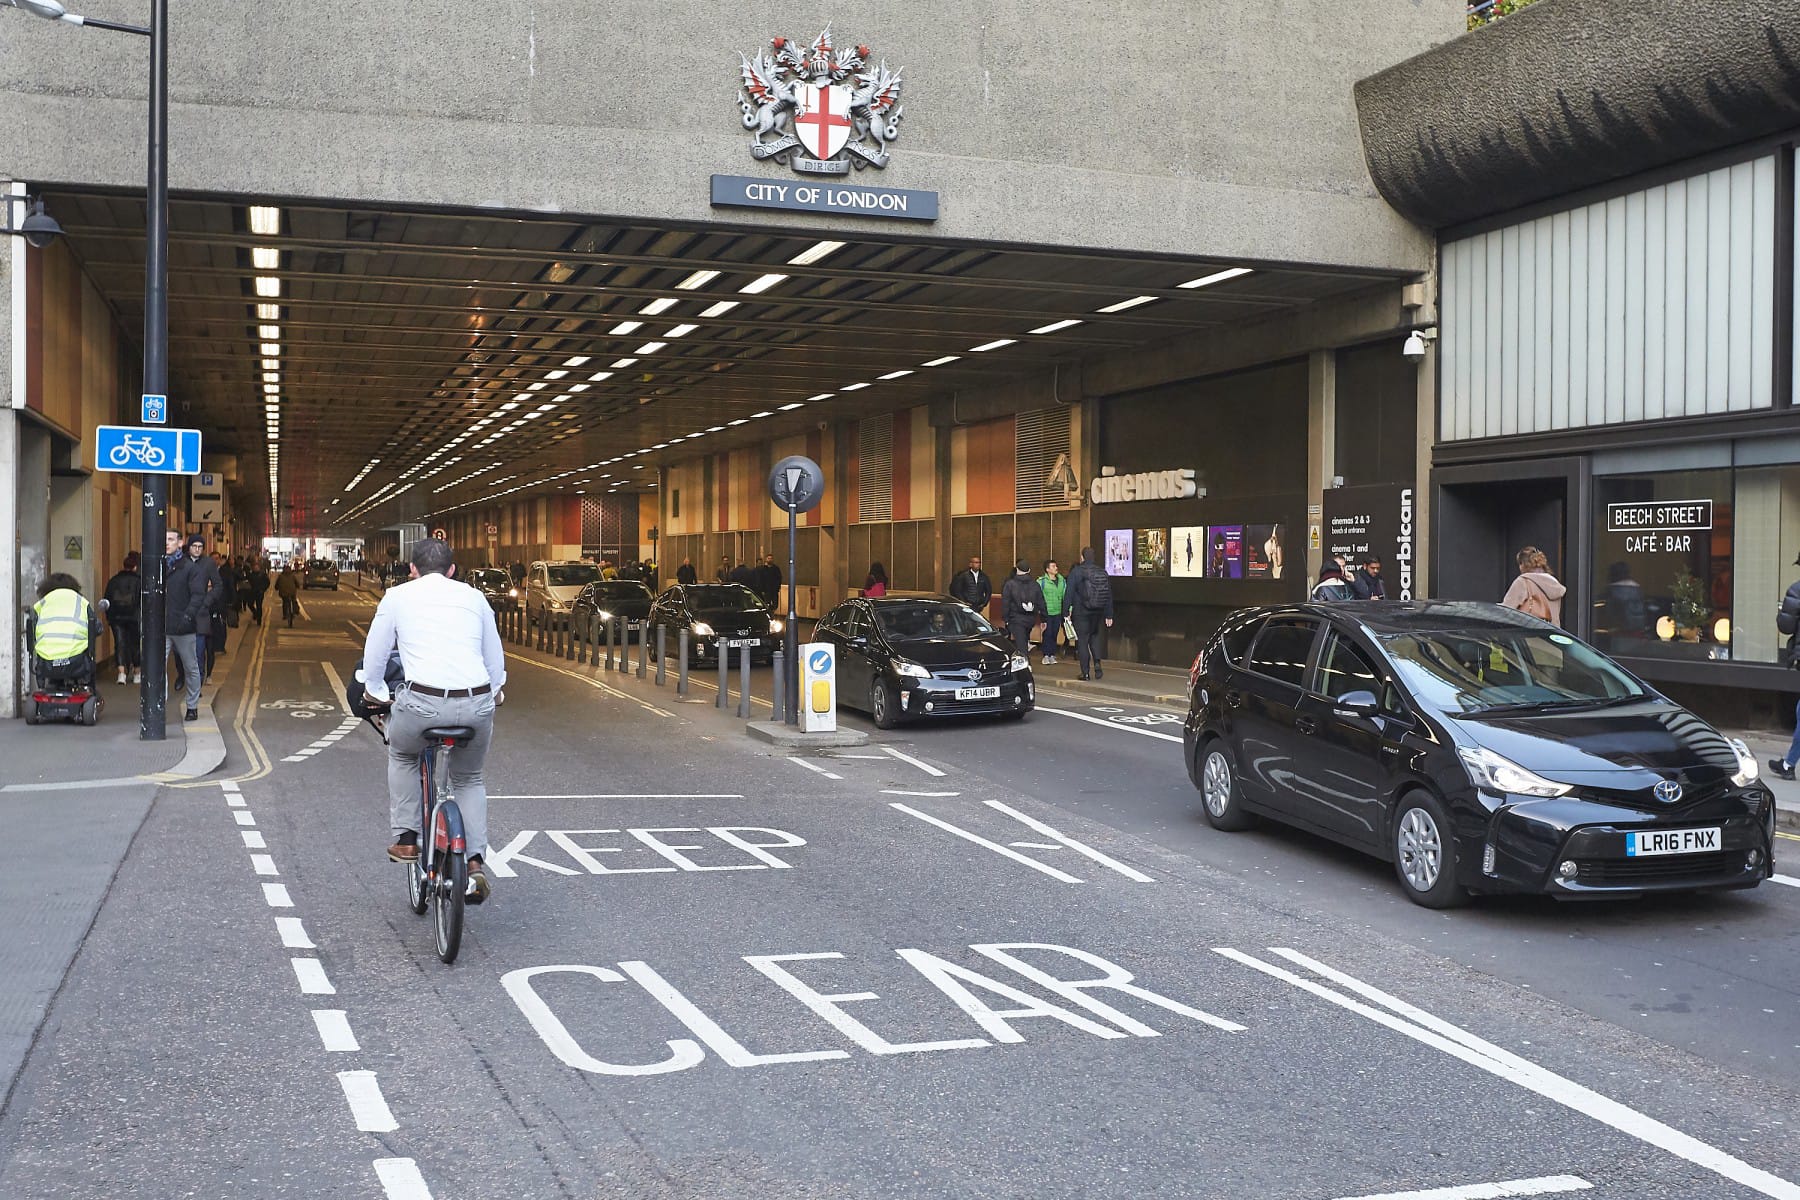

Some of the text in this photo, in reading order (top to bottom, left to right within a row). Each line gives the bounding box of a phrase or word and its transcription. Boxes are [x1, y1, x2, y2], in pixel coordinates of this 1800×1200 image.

[804, 161, 841, 172] DIRIGE
[853, 142, 878, 160] NOS
[745, 184, 907, 211] CITY OF LONDON
[1091, 466, 1196, 504] cinemas
[1331, 515, 1370, 525] cinemas 2 & 3
[1615, 506, 1704, 525] BEECH STREET
[1331, 544, 1351, 553] cinema
[1356, 543, 1369, 552] and
[1626, 531, 1691, 552] CAFÉ BAR
[960, 687, 996, 699] KF14 UBR
[485, 826, 808, 878] KEEP
[1641, 830, 1715, 852] LR16 FNX
[500, 942, 1249, 1077] CLEAR
